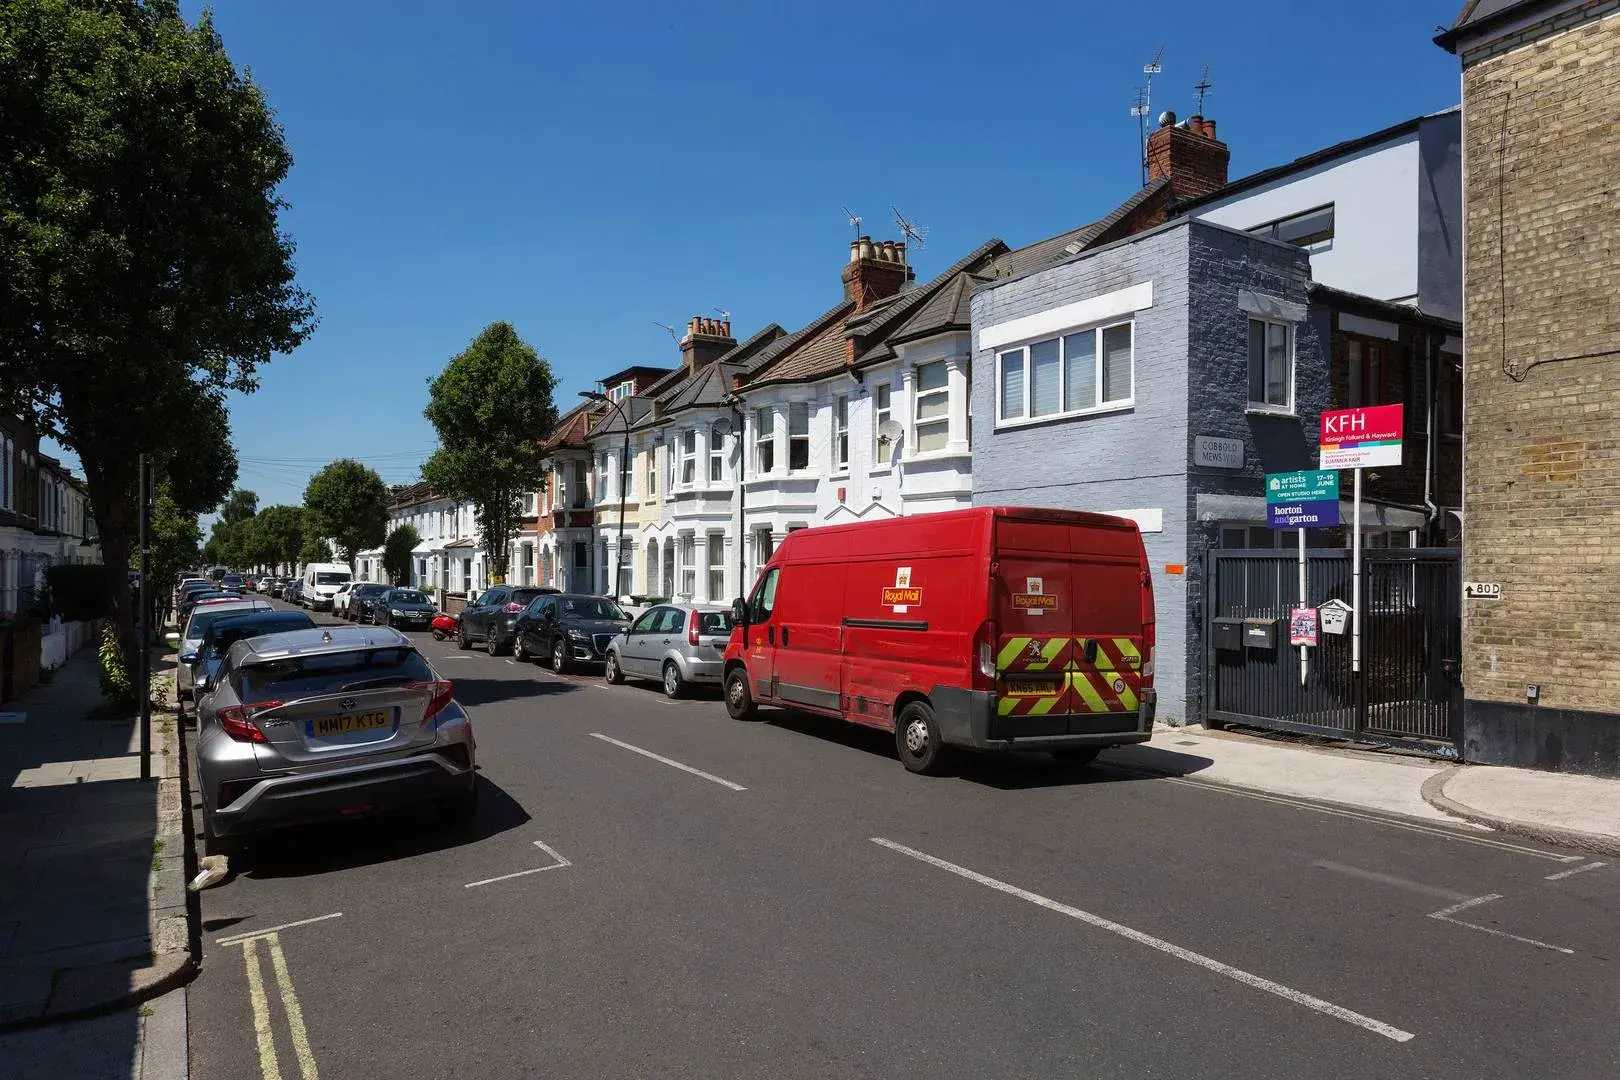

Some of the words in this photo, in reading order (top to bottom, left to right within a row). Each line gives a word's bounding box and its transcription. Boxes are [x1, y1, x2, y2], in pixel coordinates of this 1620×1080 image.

[1325, 413, 1365, 433] KFH
[1345, 433, 1365, 441] Folkard
[1371, 432, 1397, 440] Hayward
[1202, 441, 1238, 452] COBBOLD
[1202, 451, 1222, 463] MEWS
[1281, 476, 1306, 484] artists
[1274, 505, 1303, 515] horton
[1274, 514, 1319, 525] andgarton
[885, 590, 904, 603] Royal
[904, 590, 919, 601] Mail
[1015, 595, 1038, 607] Royal
[1038, 596, 1055, 606] Mail
[319, 717, 352, 733] MM17
[356, 712, 385, 728] KTG
